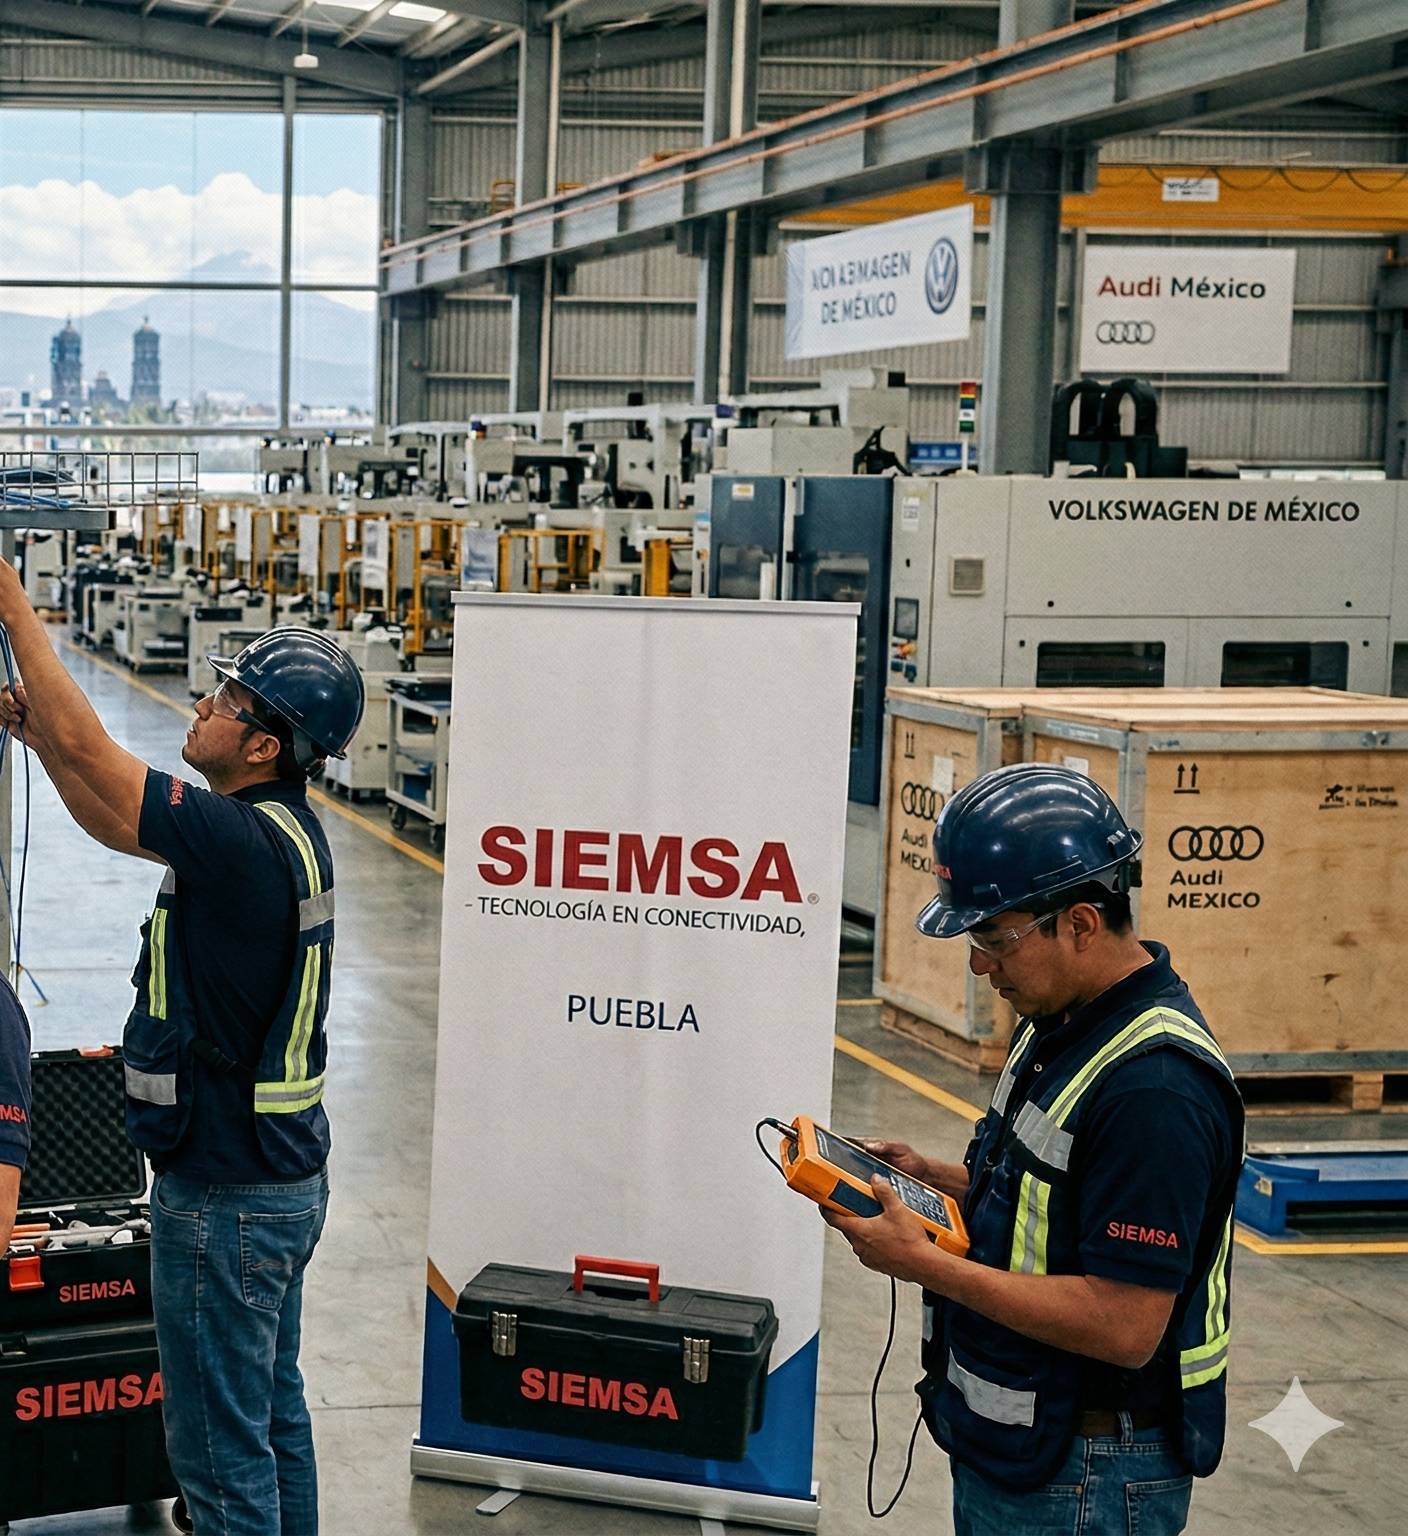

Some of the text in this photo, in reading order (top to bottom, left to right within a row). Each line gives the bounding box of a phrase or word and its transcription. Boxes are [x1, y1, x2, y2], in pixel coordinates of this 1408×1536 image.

[1098, 275, 1266, 298] Audi México
[1048, 495, 1360, 522] VOLKSWAGEN DE MÉXICO
[477, 825, 803, 904] SIEMSA
[1170, 869, 1222, 886] Audi
[1167, 892, 1260, 909] MEXICO
[478, 896, 606, 922] TECNOLOGÍA
[613, 905, 638, 924] EN
[644, 907, 806, 938] CONECTIVIDAD,
[567, 995, 700, 1033] PUEBLA
[1107, 1221, 1178, 1249] SIEMSA
[59, 1278, 136, 1303] SIEMSA
[15, 1371, 165, 1421] SIEMSA
[520, 1367, 679, 1420] SIEMSA
